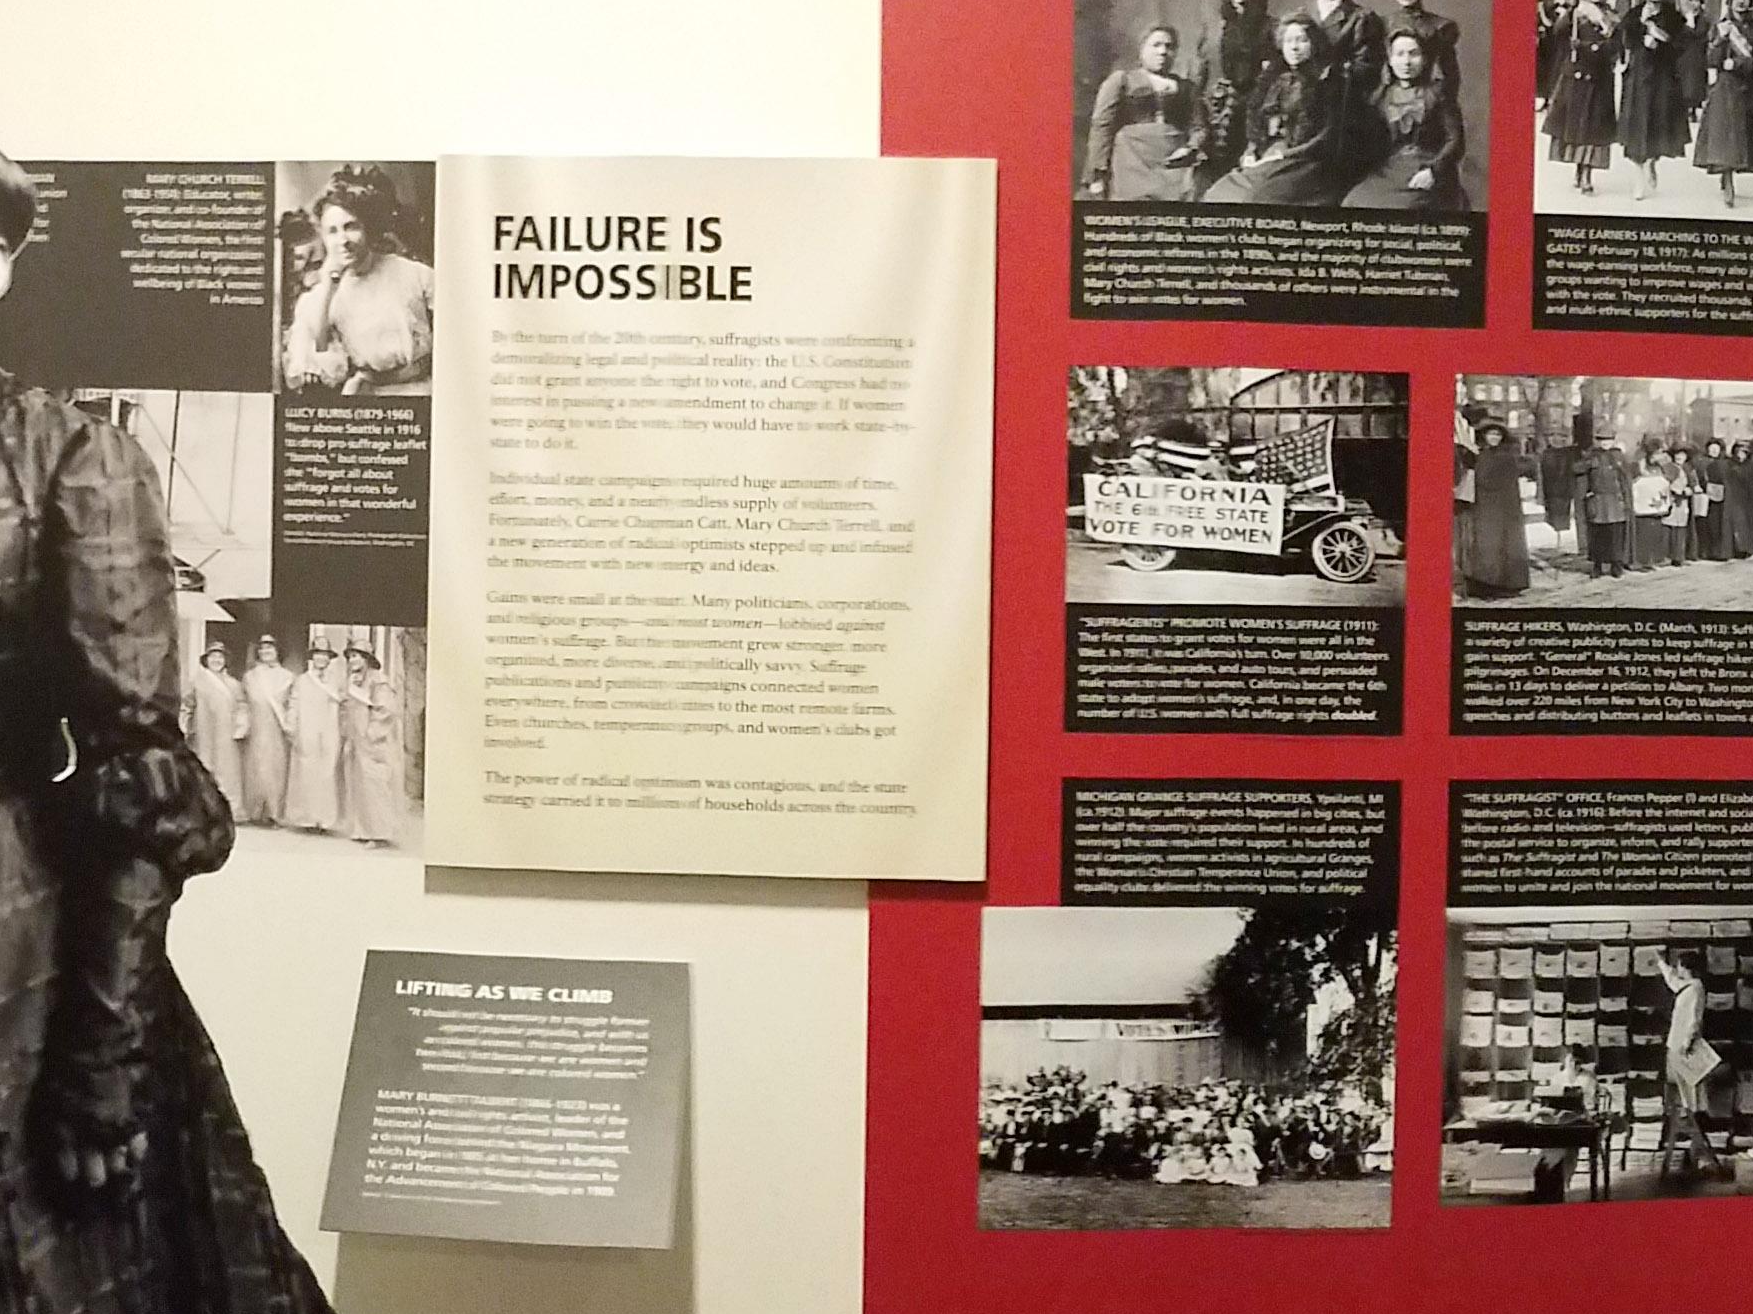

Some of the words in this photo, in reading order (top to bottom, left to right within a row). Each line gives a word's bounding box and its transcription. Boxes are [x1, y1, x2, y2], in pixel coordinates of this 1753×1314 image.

[493, 214, 667, 252] FAILURE
[685, 215, 722, 254] IS
[1702, 232, 1719, 244] TO
[493, 262, 752, 301] IMPOSSIBLE
[1096, 479, 1272, 506] CALIFORNIA
[1214, 506, 1269, 524] STATE
[1087, 516, 1140, 536] VOTE
[1152, 521, 1194, 538] FOR
[1201, 524, 1272, 544] WOMEN
[394, 979, 473, 998] LIFTING
[473, 983, 505, 1000] AS
[546, 986, 613, 1004] CLIMB
